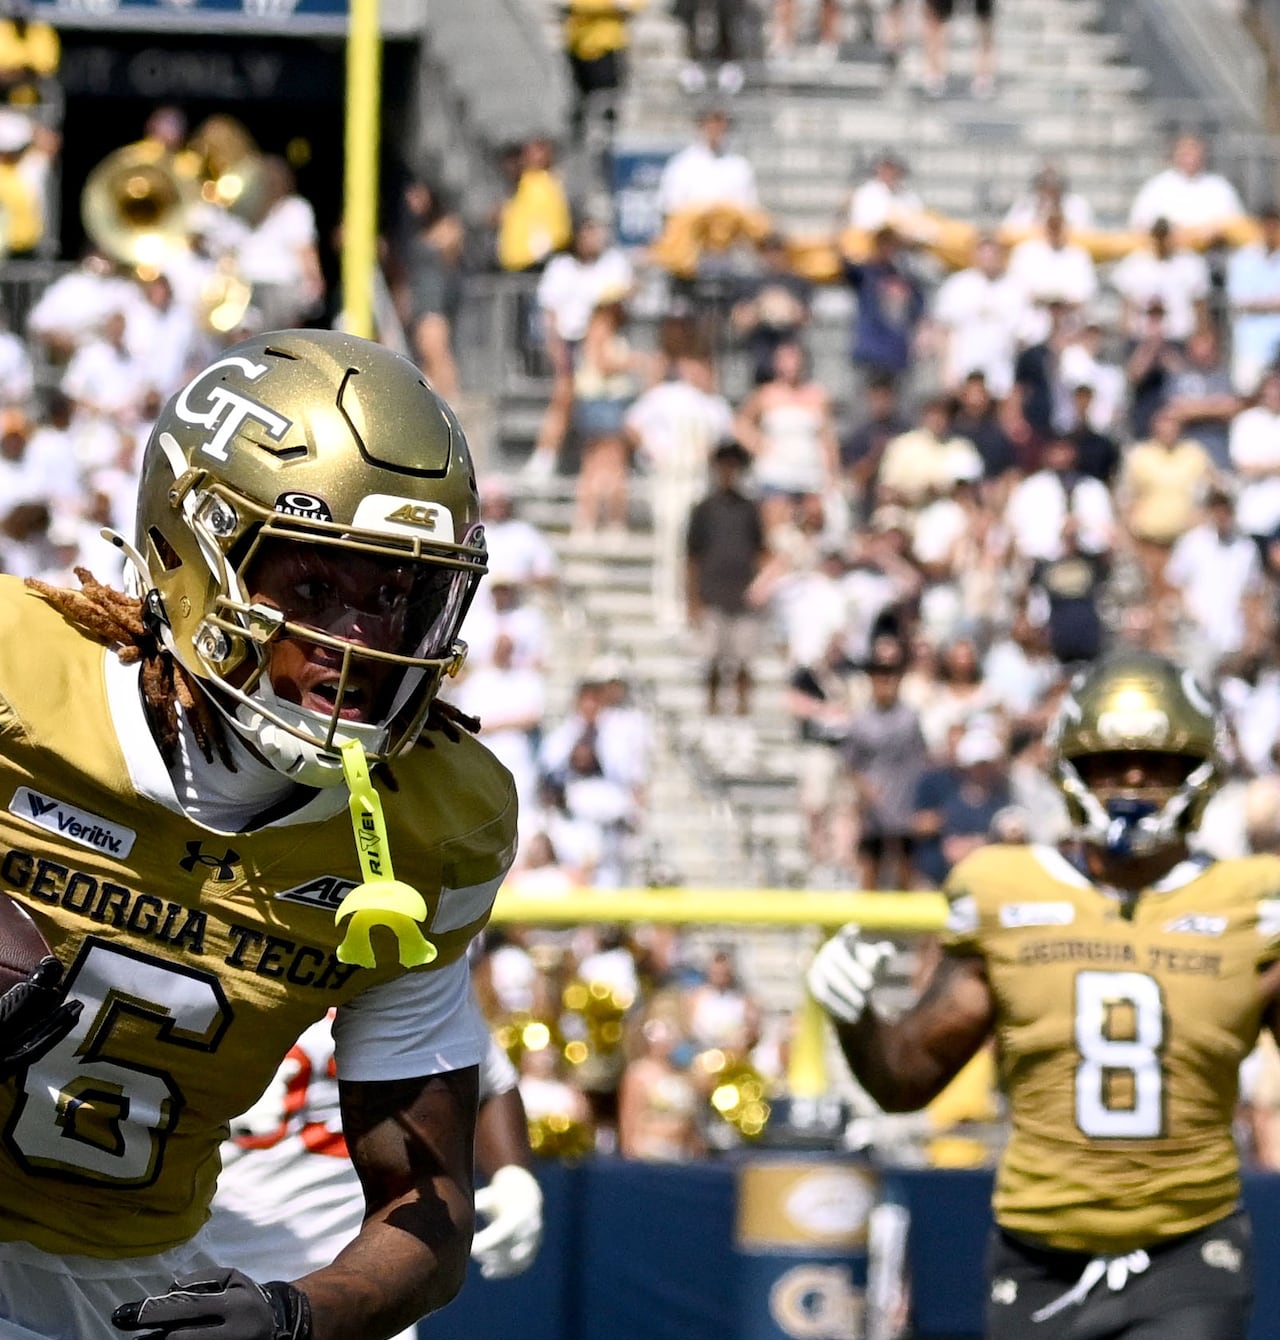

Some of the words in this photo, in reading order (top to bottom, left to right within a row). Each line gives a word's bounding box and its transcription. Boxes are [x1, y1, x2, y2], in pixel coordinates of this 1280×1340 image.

[175, 356, 293, 462] GT
[385, 503, 440, 528] ACC
[358, 811, 383, 877] RIVE
[1, 850, 208, 955] GEORGIA
[224, 925, 361, 990] TECH
[295, 877, 361, 908] AC
[1019, 939, 1137, 967] GEORGIA
[1149, 946, 1222, 976] TECH
[2, 936, 234, 1190] 6
[1075, 970, 1165, 1140] 8
